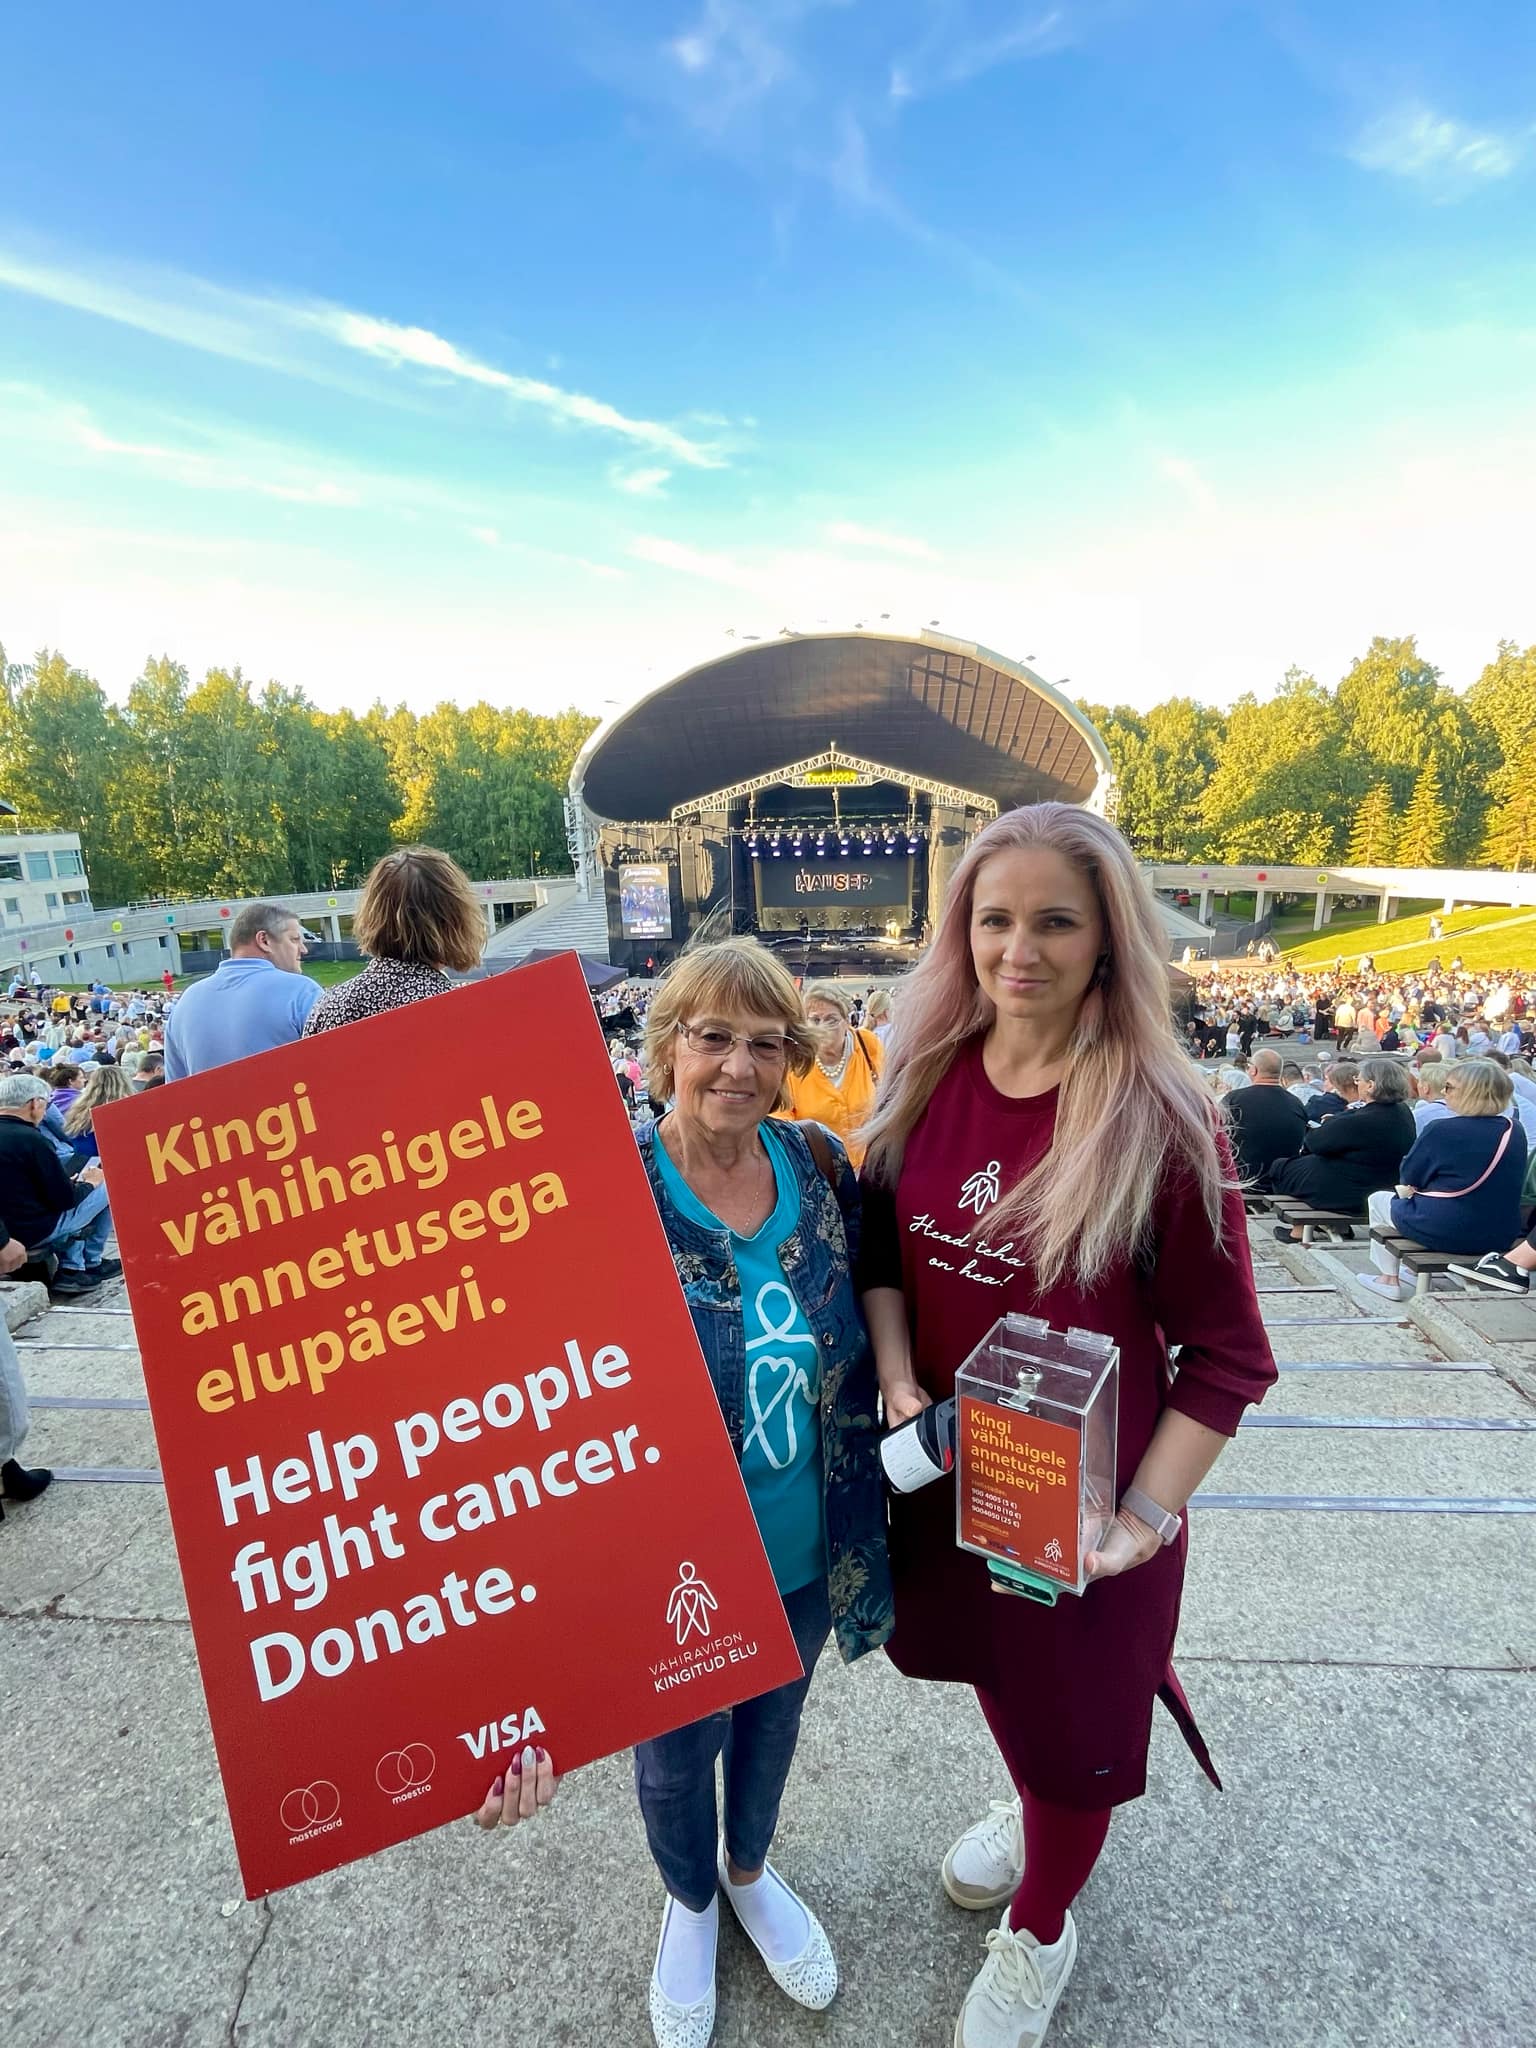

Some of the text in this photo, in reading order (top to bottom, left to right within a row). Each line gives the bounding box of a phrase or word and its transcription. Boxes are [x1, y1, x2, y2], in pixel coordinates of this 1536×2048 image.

[145, 1082, 318, 1185] Kingi
[160, 1095, 544, 1258] vähihaigele
[179, 1170, 568, 1337] annetusega
[909, 1213, 1026, 1267] Head teha
[928, 1256, 1015, 1286] on hea!
[196, 1266, 507, 1414] elupäevi.
[215, 1343, 633, 1528] Help people
[970, 1408, 1011, 1434] Kingi
[970, 1427, 1066, 1468] vähihaigele
[971, 1445, 1067, 1486] annetusega
[971, 1461, 1039, 1494] elupäevi
[231, 1422, 661, 1614] fight cancer.
[249, 1565, 537, 1703] Donate.
[649, 1631, 743, 1676] VÄHIRAVIFON
[654, 1640, 758, 1693] KINGITUD ELU
[456, 1706, 546, 1760] VISA
[391, 1782, 432, 1806] maestro
[289, 1817, 343, 1846] mastercard
